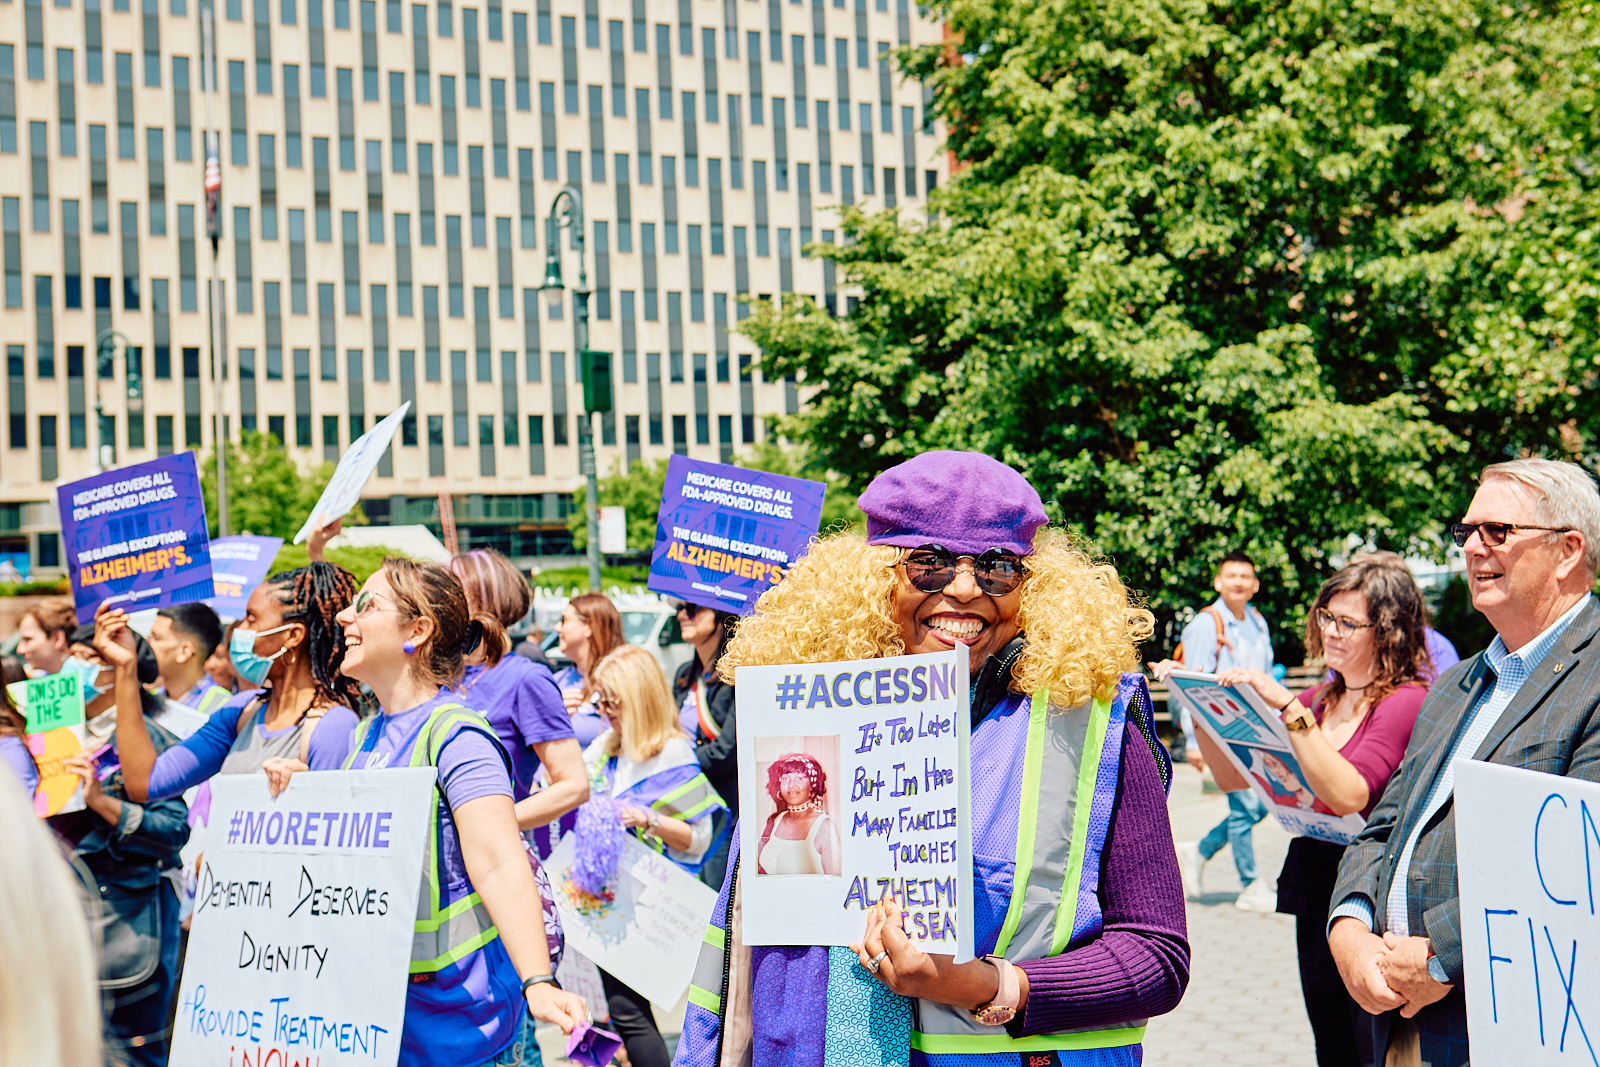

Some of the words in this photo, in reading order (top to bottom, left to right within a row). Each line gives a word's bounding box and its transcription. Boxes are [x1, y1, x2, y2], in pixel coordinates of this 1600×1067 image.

[73, 484, 114, 506] MEDICARE
[114, 475, 152, 496] COVERS
[152, 471, 172, 487] ALL
[73, 494, 138, 522] FDA-APPROVED
[138, 485, 177, 505] DRUGS.
[681, 485, 754, 511] FDA-APPROVED
[754, 501, 793, 519] DRUGS.
[687, 471, 732, 491] MEDICARE
[733, 480, 773, 500] COVERS
[773, 489, 793, 504] ALL
[77, 551, 92, 564] THE
[92, 541, 129, 560] GLARING
[129, 529, 187, 552] EXCEPTION:
[673, 526, 690, 541] THE
[690, 531, 729, 550] GLARING
[730, 539, 788, 563] EXCEPTION:
[80, 545, 193, 587] ALZHEIMER'S.
[59, 676, 75, 698] DO
[36, 699, 62, 724] THE
[850, 765, 886, 802] But
[227, 810, 393, 848] #MORETIME
[198, 861, 272, 914] DEMENTIA
[288, 865, 389, 918] DESERVES
[844, 875, 957, 911] ALZHEIM
[238, 930, 328, 979] DIGNITY
[1484, 907, 1600, 1067] FIX
[270, 997, 388, 1059] TREATMENT
